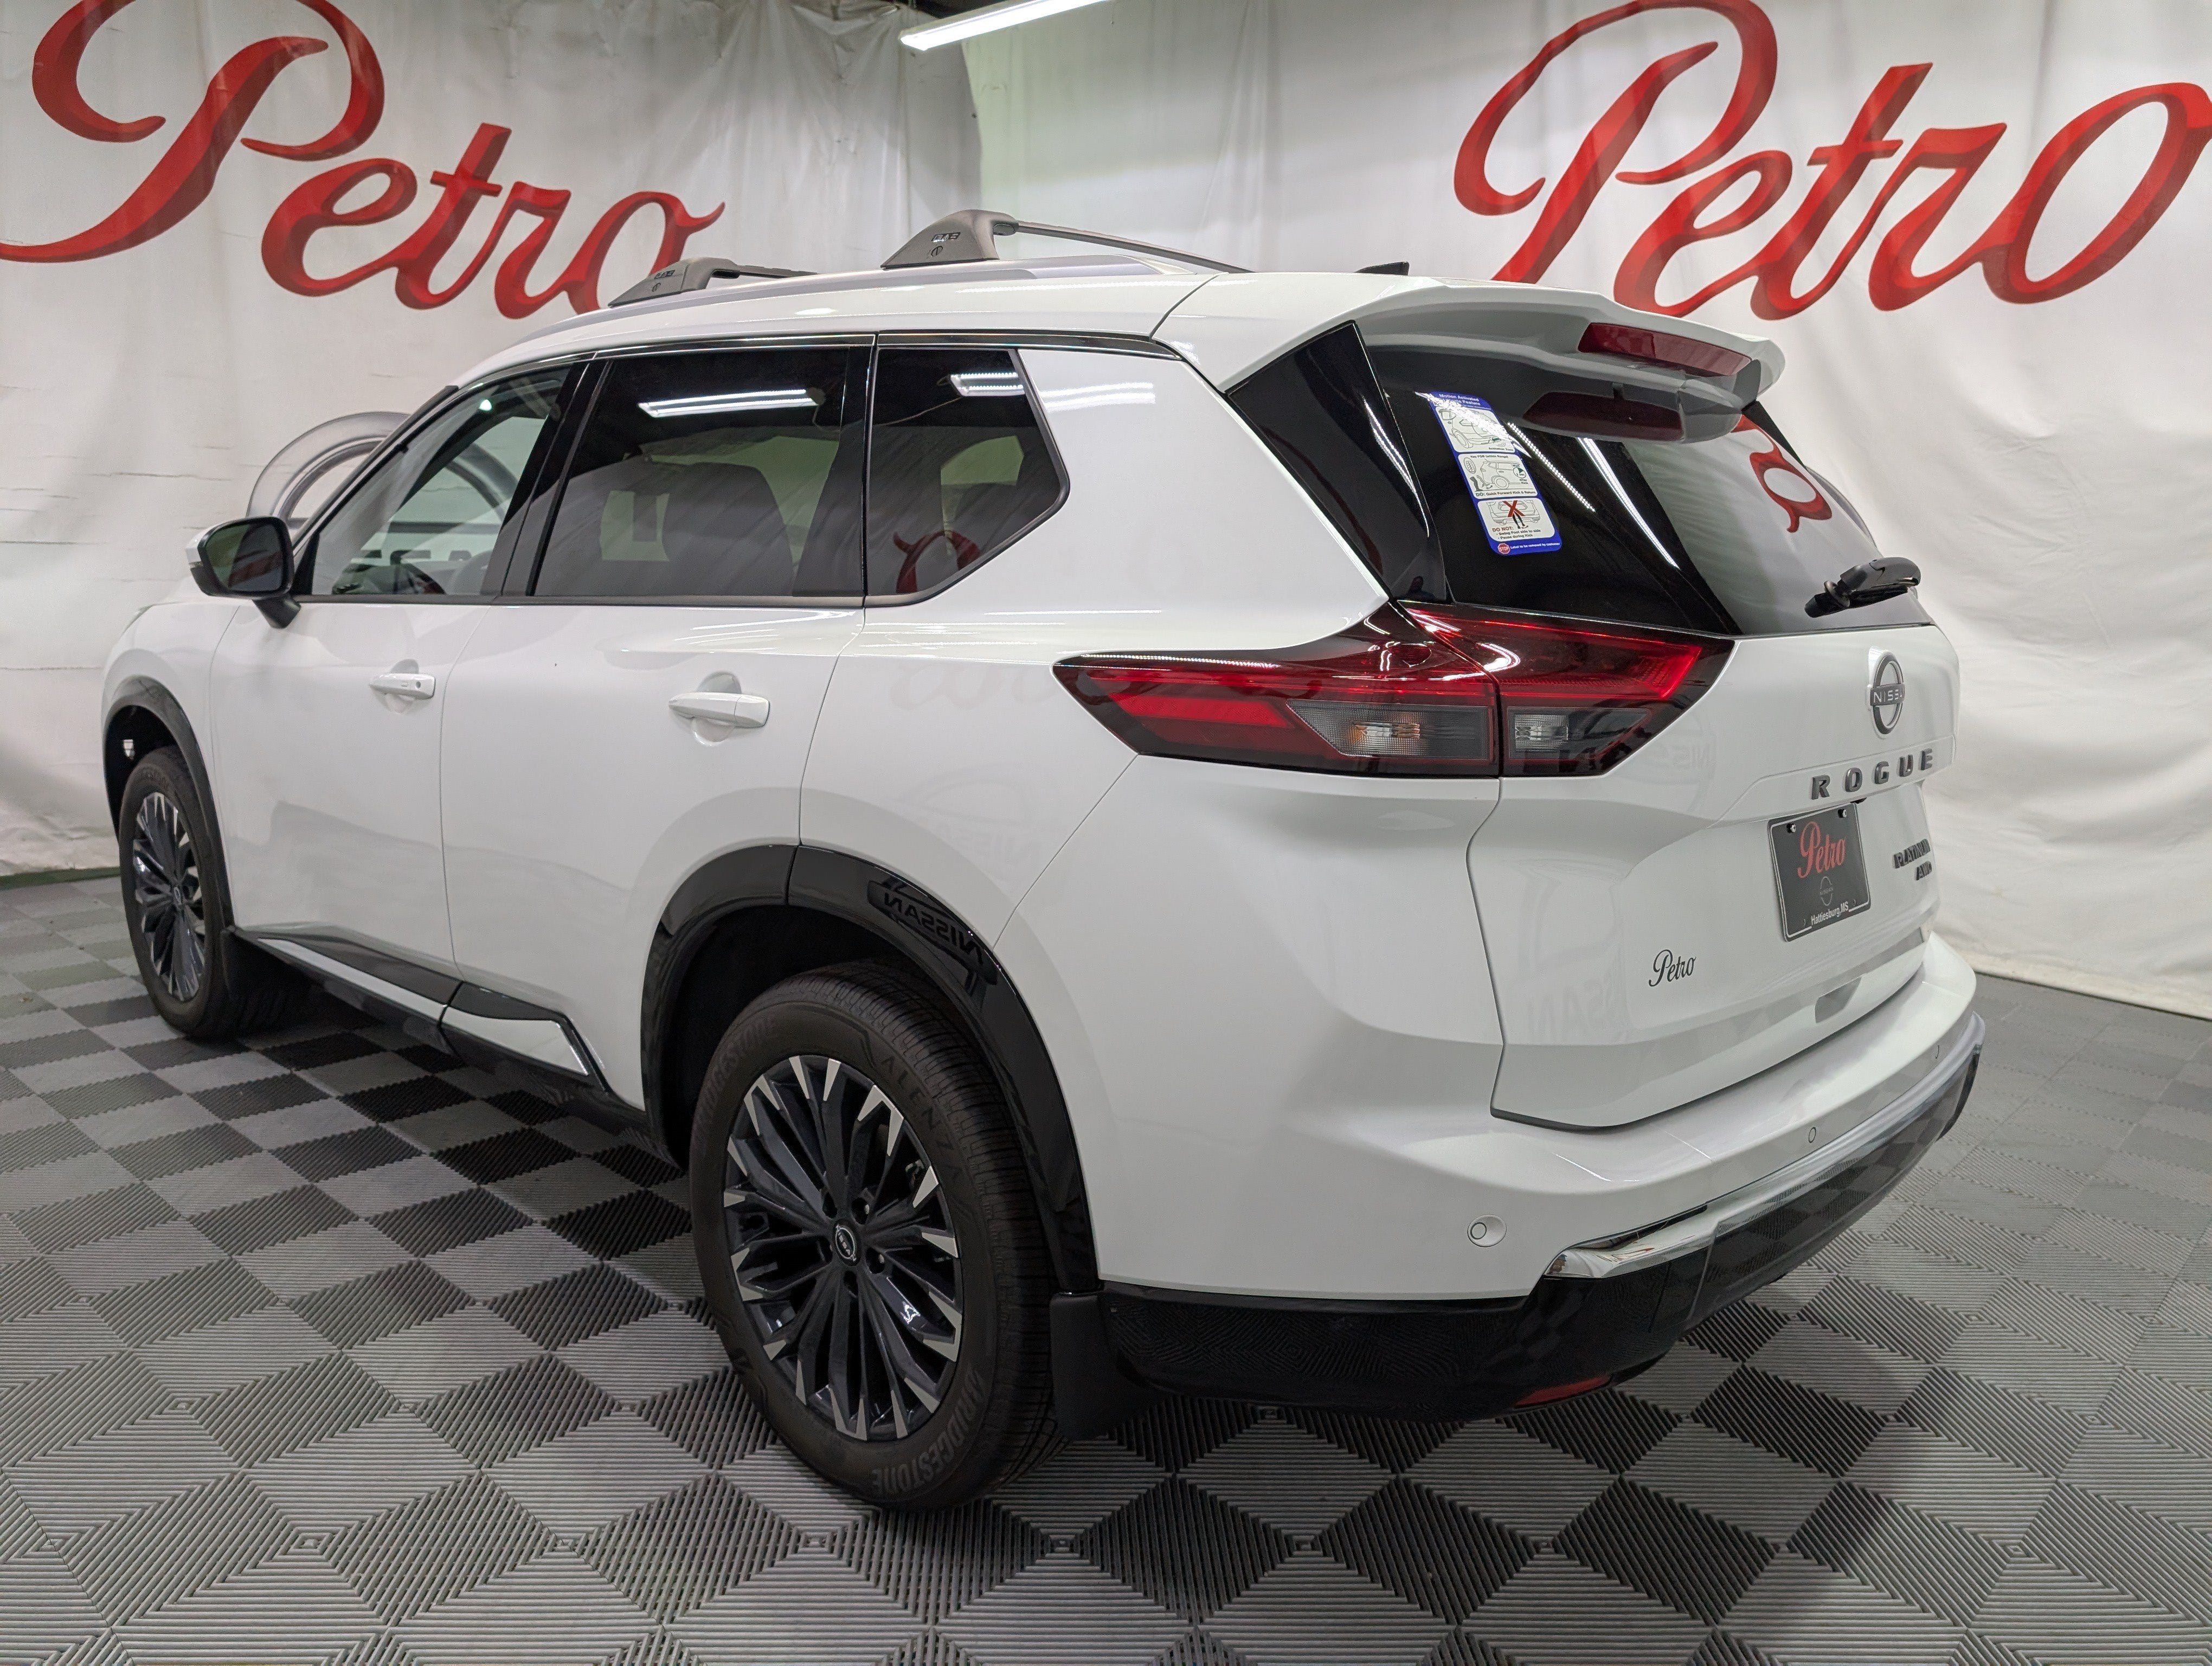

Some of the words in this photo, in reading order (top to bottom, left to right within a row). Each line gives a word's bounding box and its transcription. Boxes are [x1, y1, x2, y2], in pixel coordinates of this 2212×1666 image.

[0, 0, 725, 319] Petro
[1454, 0, 2212, 320] Petro
[1873, 689, 1904, 703] NISS
[1811, 748, 1933, 800] ROGUE
[1797, 821, 1847, 879] Petro
[1648, 949, 1697, 987] Petro
[871, 1366, 987, 1494] BRIDGESTONE
